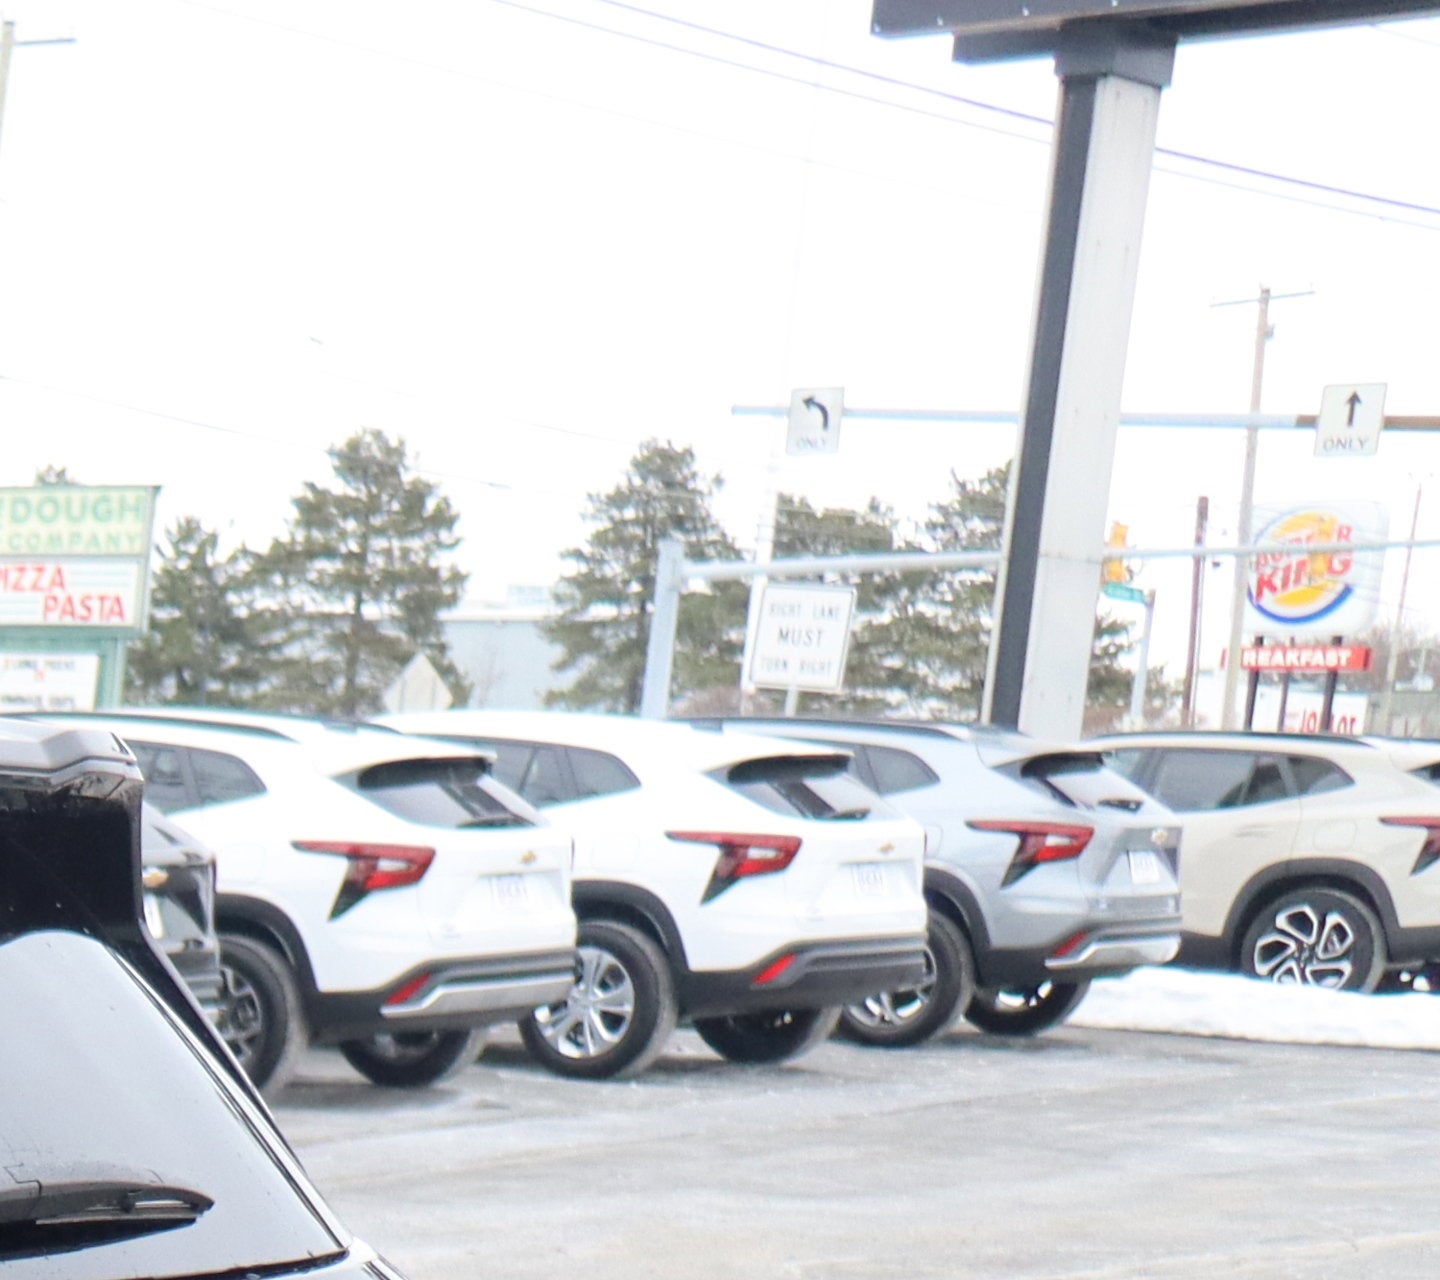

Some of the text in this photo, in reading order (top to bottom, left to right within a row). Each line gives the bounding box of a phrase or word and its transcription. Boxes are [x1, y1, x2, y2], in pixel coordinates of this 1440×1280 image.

[795, 436, 828, 450] ONLY
[1322, 436, 1369, 452] ONLY
[8, 494, 142, 525] DOUGH
[7, 531, 140, 551] COMPANY
[42, 595, 125, 622] PASTA
[779, 626, 825, 648] MUST
[1242, 649, 1351, 667] REAKFAST
